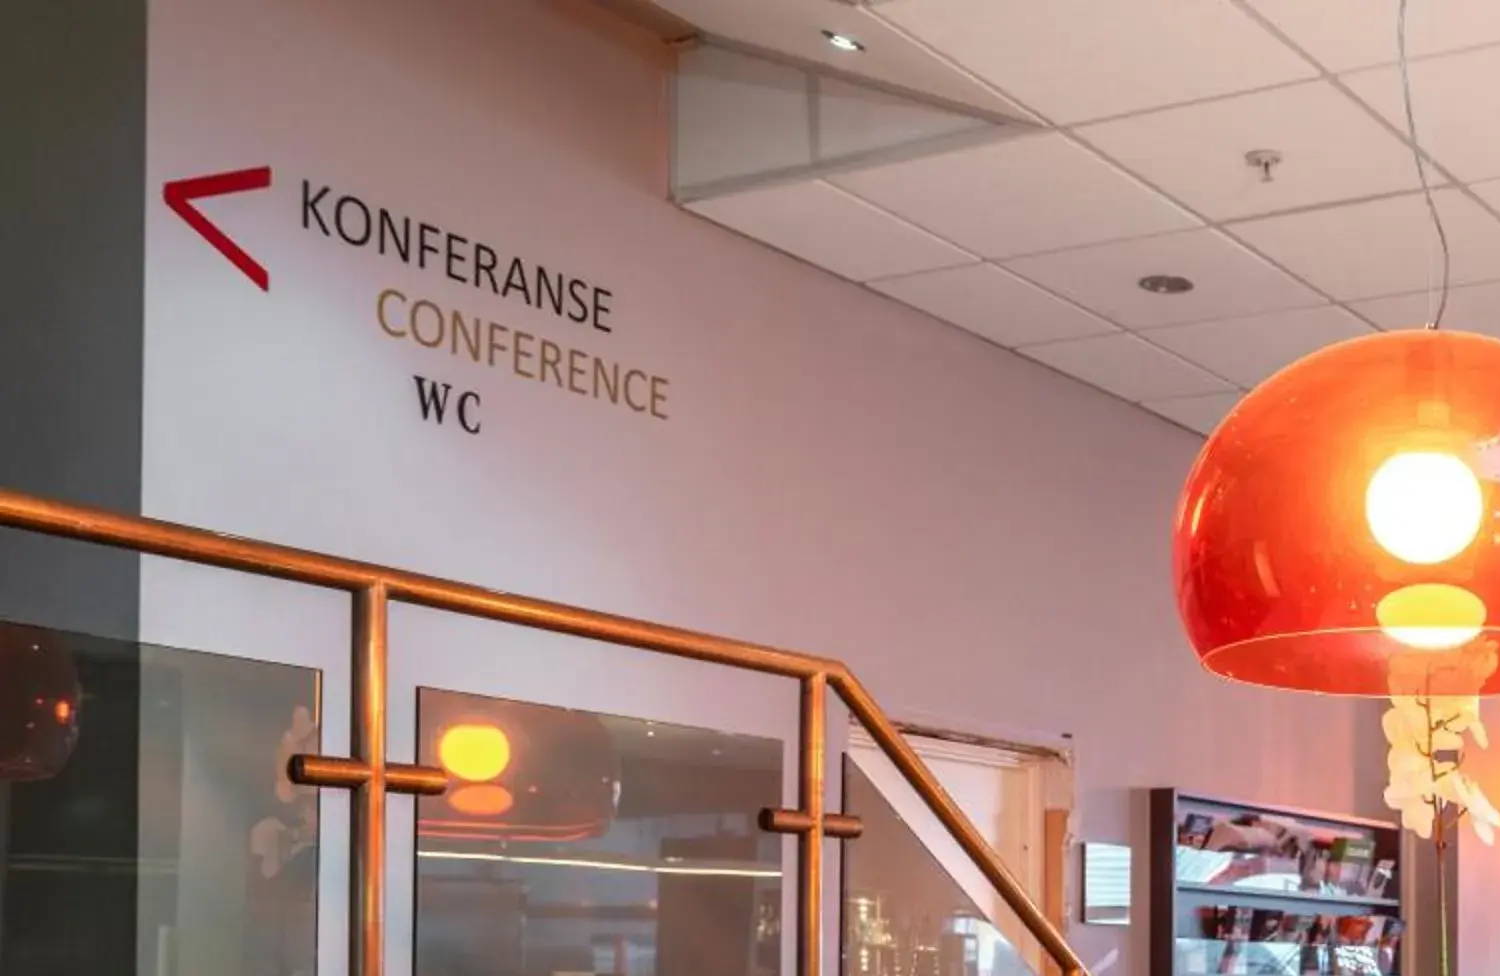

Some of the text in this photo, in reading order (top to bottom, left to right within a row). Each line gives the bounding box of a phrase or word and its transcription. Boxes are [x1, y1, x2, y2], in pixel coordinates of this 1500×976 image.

[301, 179, 613, 333] KONFERANSE
[376, 288, 670, 421] CONFERENCE
[412, 375, 482, 435] WC
